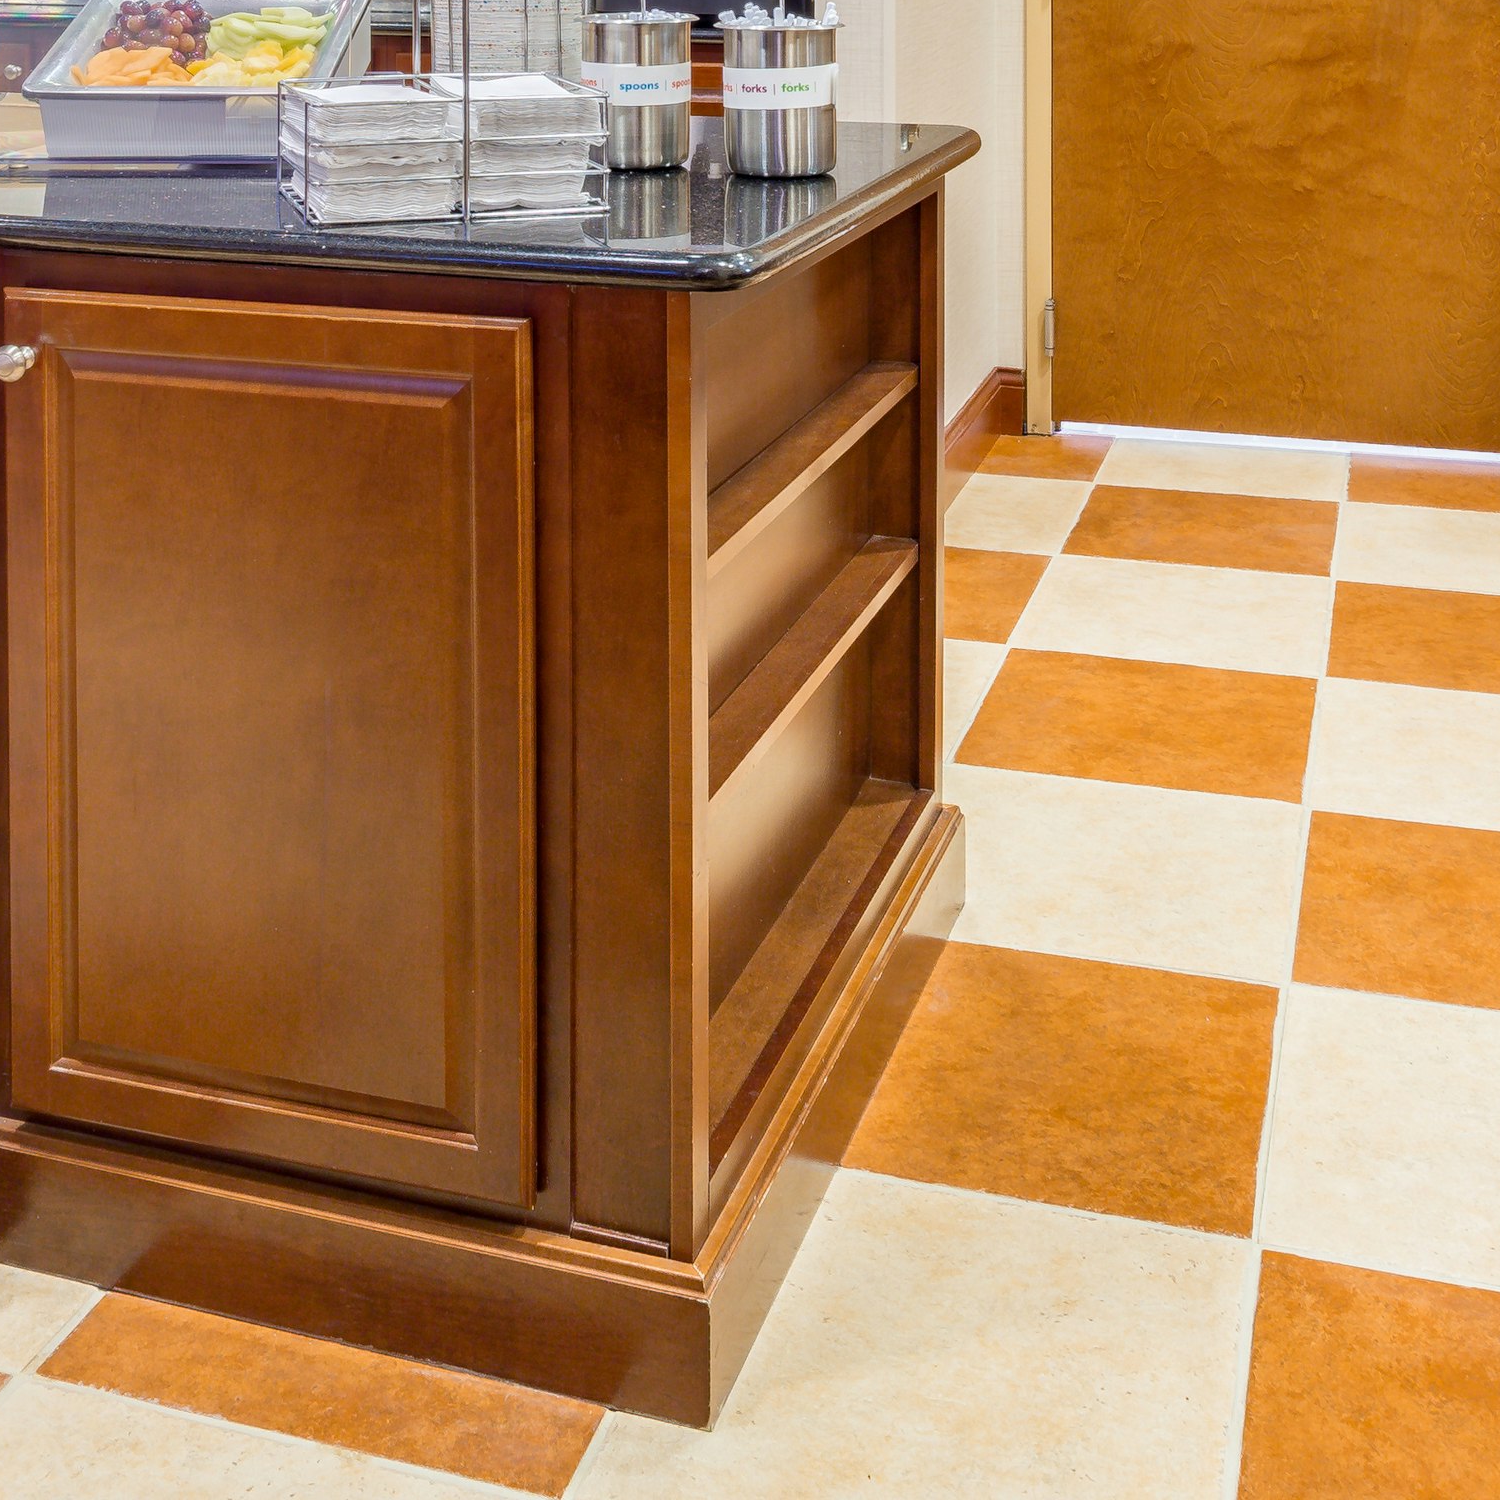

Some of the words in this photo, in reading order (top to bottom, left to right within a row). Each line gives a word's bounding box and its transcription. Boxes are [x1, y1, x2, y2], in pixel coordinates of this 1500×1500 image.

[619, 81, 659, 92] spoons
[741, 83, 768, 94] forks
[781, 82, 810, 93] forks
